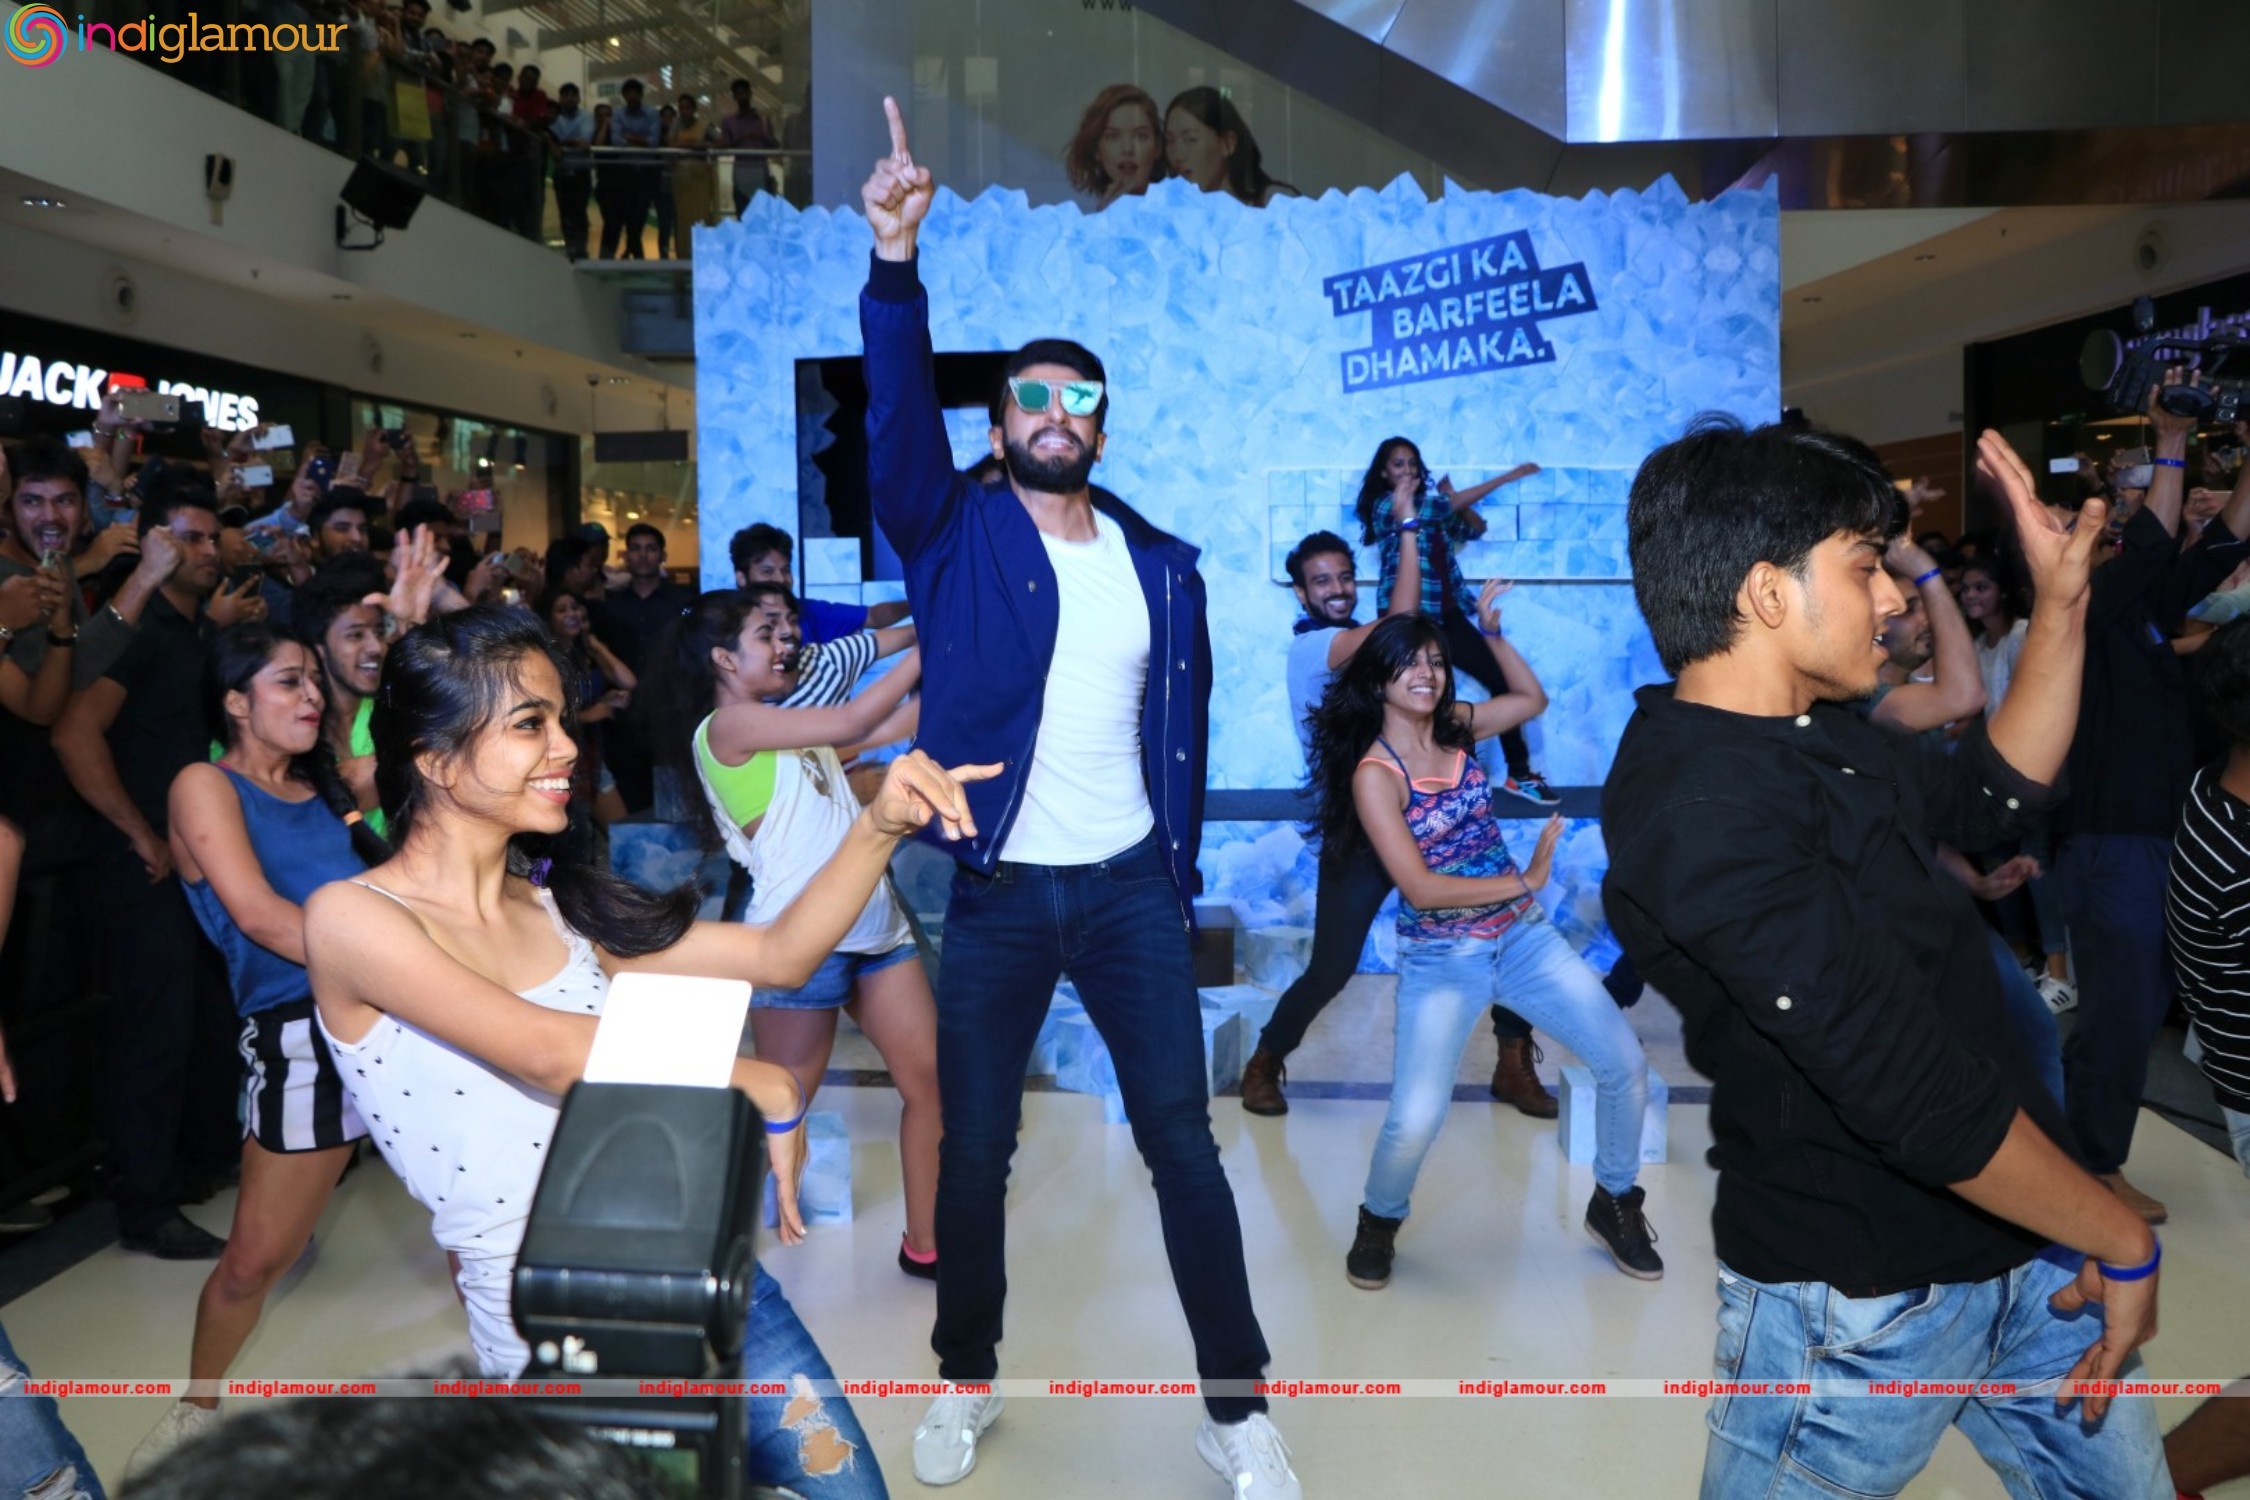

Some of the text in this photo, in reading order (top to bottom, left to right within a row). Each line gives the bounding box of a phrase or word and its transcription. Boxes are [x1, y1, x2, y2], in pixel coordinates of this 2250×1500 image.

[1333, 239, 1528, 310] TAAZGI KA
[1392, 272, 1587, 340] BARFEELA
[0, 351, 108, 411] JACK
[1346, 327, 1546, 386] DHAMAKA.
